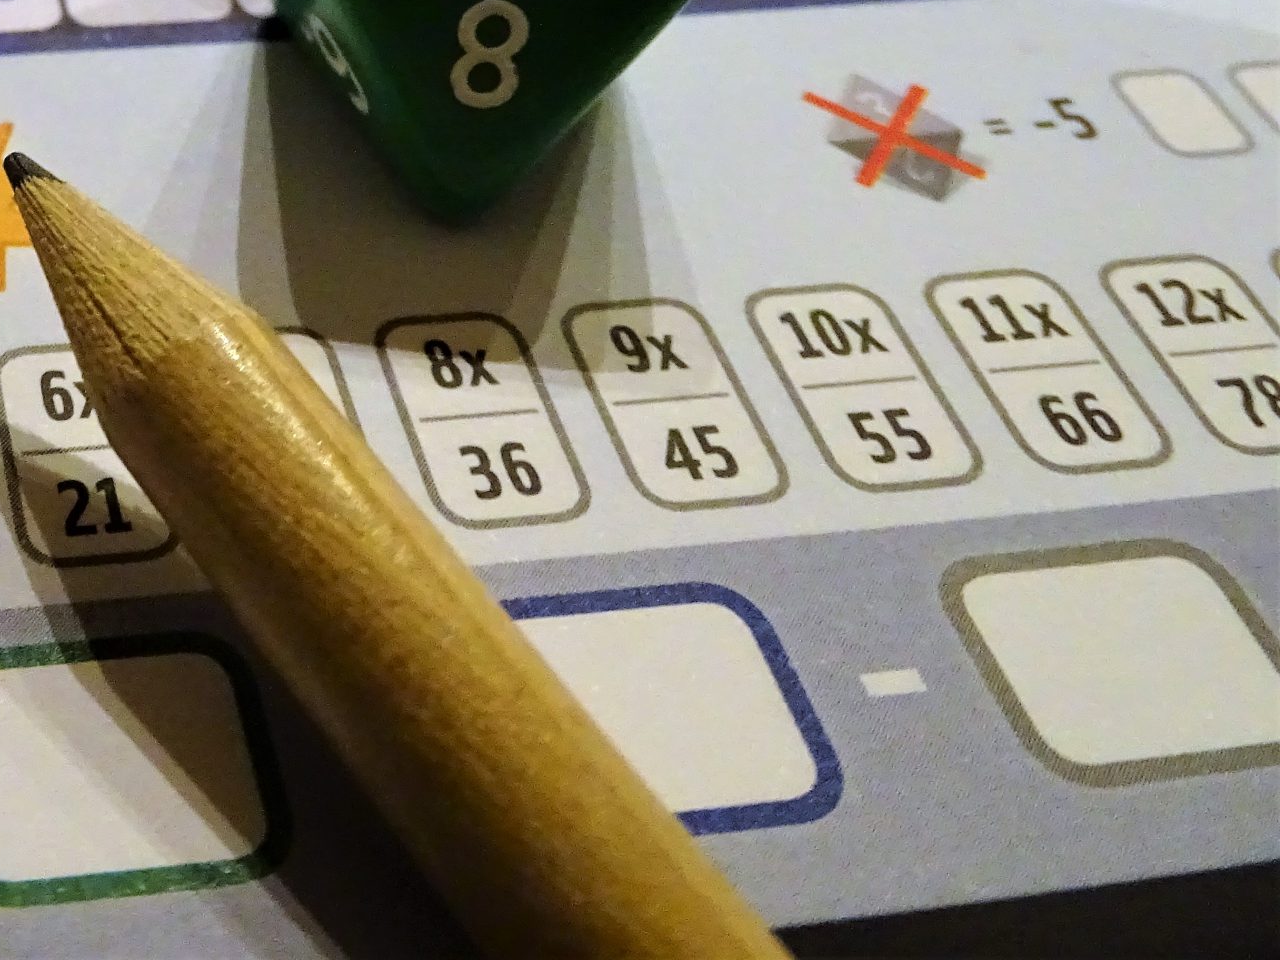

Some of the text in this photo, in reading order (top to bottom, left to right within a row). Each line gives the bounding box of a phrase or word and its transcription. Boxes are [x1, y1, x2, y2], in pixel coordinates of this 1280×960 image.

[1034, 97, 1098, 139] -5
[423, 339, 498, 390] 8x
[610, 323, 690, 374] 9x
[778, 308, 888, 358] 10x
[960, 293, 1070, 343] 11x
[1134, 279, 1247, 326] 12x
[57, 477, 134, 538] 21
[458, 441, 544, 500] 36
[663, 424, 740, 481] 45
[847, 407, 931, 464] 55
[1038, 391, 1124, 446] 66
